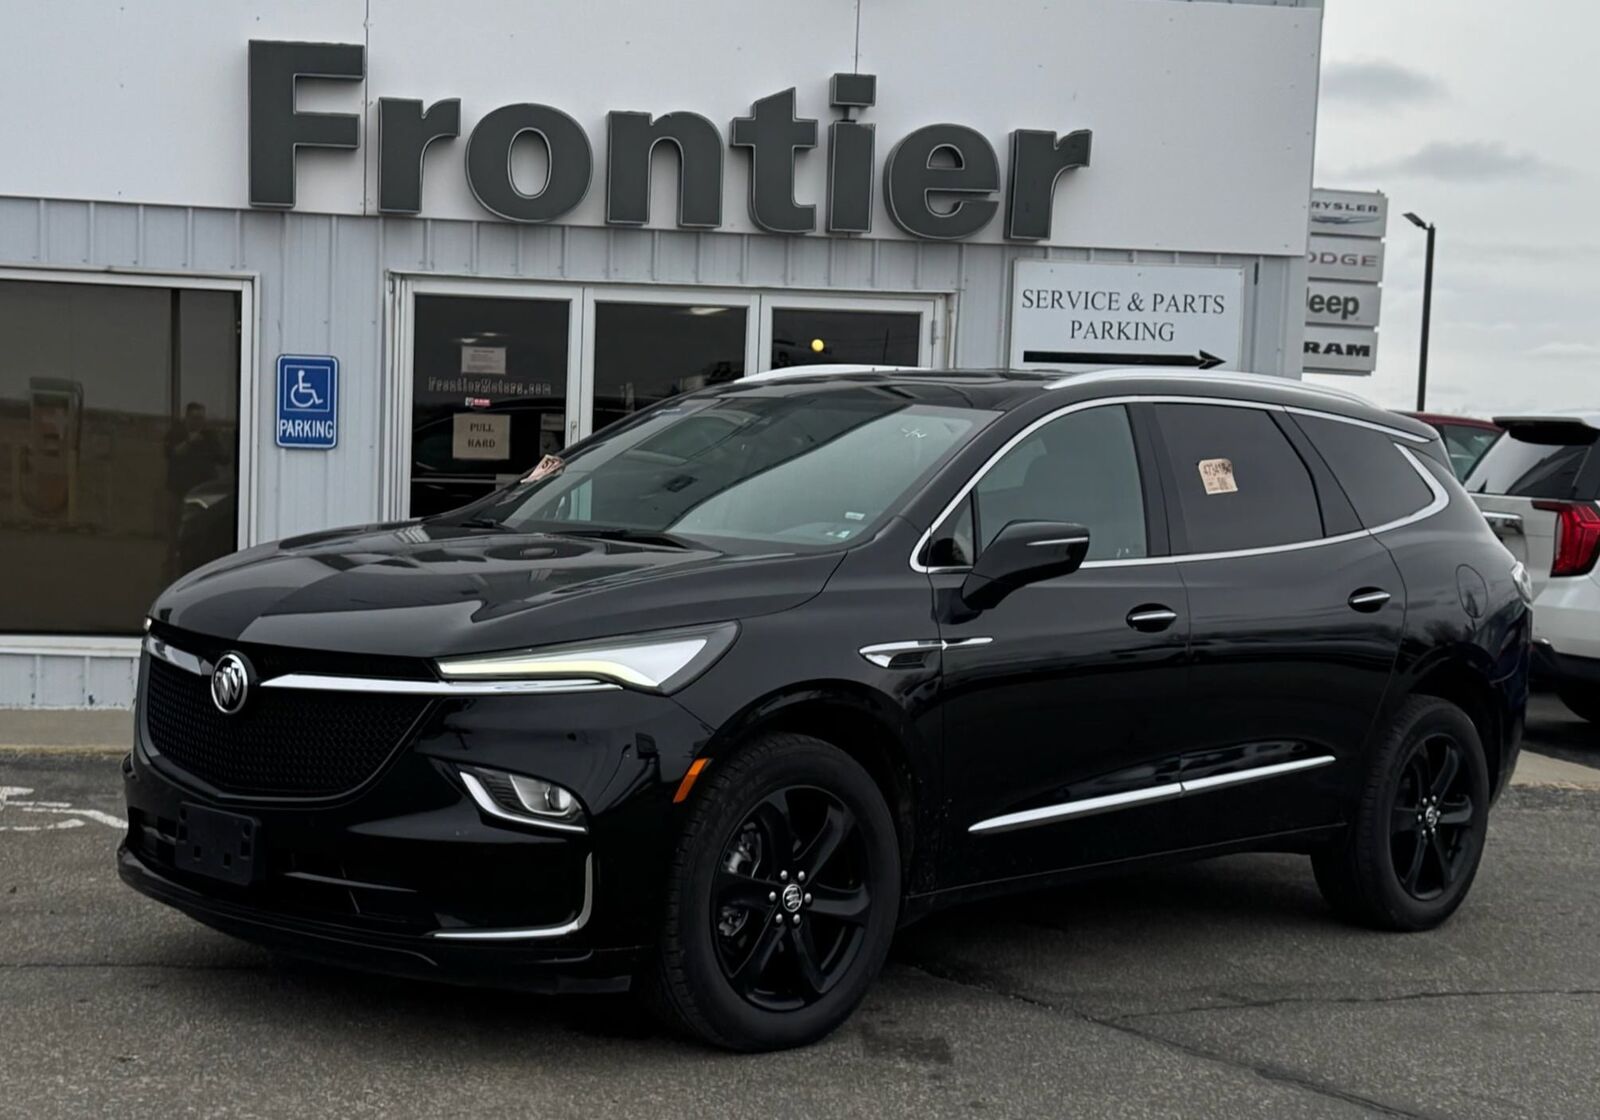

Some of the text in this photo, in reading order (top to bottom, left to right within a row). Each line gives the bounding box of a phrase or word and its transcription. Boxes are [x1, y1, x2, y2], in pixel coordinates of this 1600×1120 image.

[248, 40, 1092, 241] Frontier
[1310, 201, 1378, 213] RYSLER
[1021, 289, 1225, 314] SERVICE & PARTS
[1306, 287, 1360, 320] eep
[1070, 320, 1175, 342] PARKING
[1303, 341, 1371, 357] RAM
[279, 420, 333, 438] PARKING
[469, 422, 495, 433] PULL
[467, 439, 496, 448] HARD
